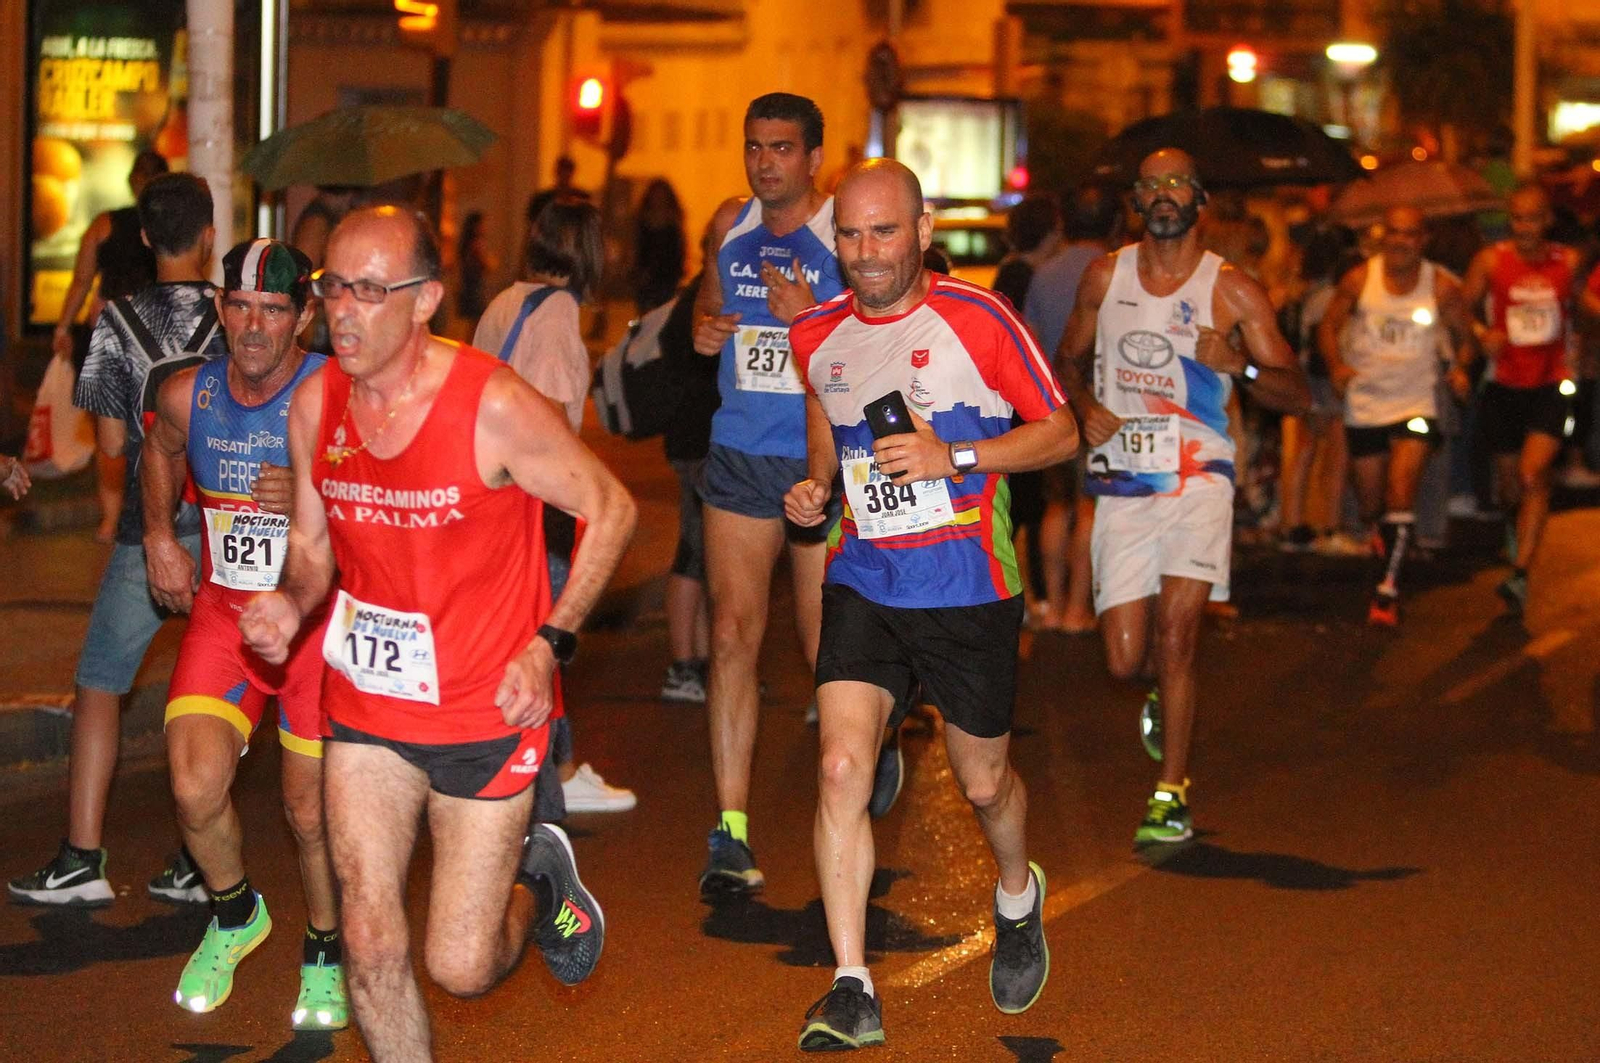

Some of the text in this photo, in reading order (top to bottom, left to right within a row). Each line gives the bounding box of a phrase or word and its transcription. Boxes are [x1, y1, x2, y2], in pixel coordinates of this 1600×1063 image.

[735, 284, 769, 298] XERE
[747, 347, 789, 373] 237
[1115, 367, 1175, 389] TOYOTA
[1119, 432, 1156, 454] 191
[219, 458, 261, 493] PERE
[321, 477, 461, 510] CORRECAMINOS
[864, 481, 917, 514] 384
[230, 524, 246, 535] DE
[354, 506, 465, 528] PALMA
[223, 534, 272, 567] 621
[345, 631, 402, 673] 172
